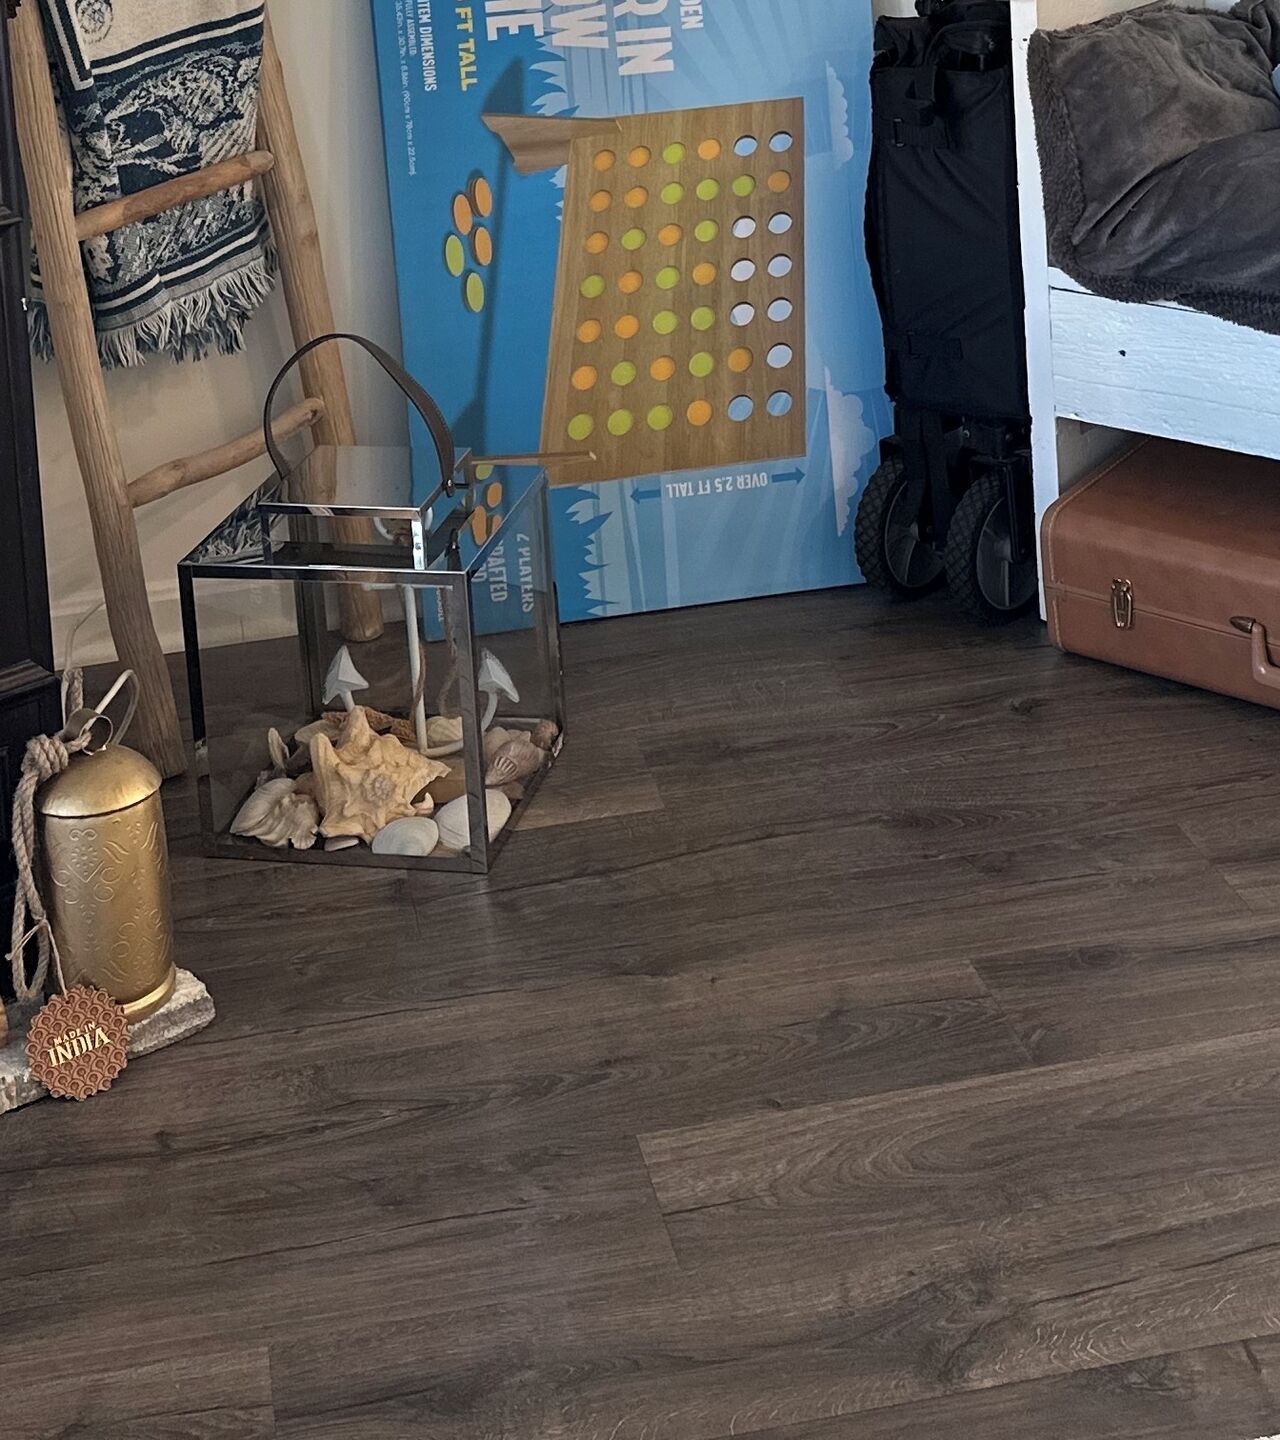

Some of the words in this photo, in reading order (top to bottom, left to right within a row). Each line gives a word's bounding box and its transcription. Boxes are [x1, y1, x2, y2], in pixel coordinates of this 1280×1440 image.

[405, 0, 414, 17] FULLY
[455, 7, 473, 33] FT
[419, 26, 437, 91] DIMENSIONS
[616, 26, 674, 76] IN
[459, 38, 478, 92] TALL
[666, 482, 694, 498] TALL
[697, 479, 711, 495] FT
[714, 476, 733, 492] 2.5
[737, 472, 768, 489] OVER
[518, 547, 534, 613] PLAYERS
[84, 1022, 97, 1033] IN
[48, 1027, 111, 1067] INDIA
